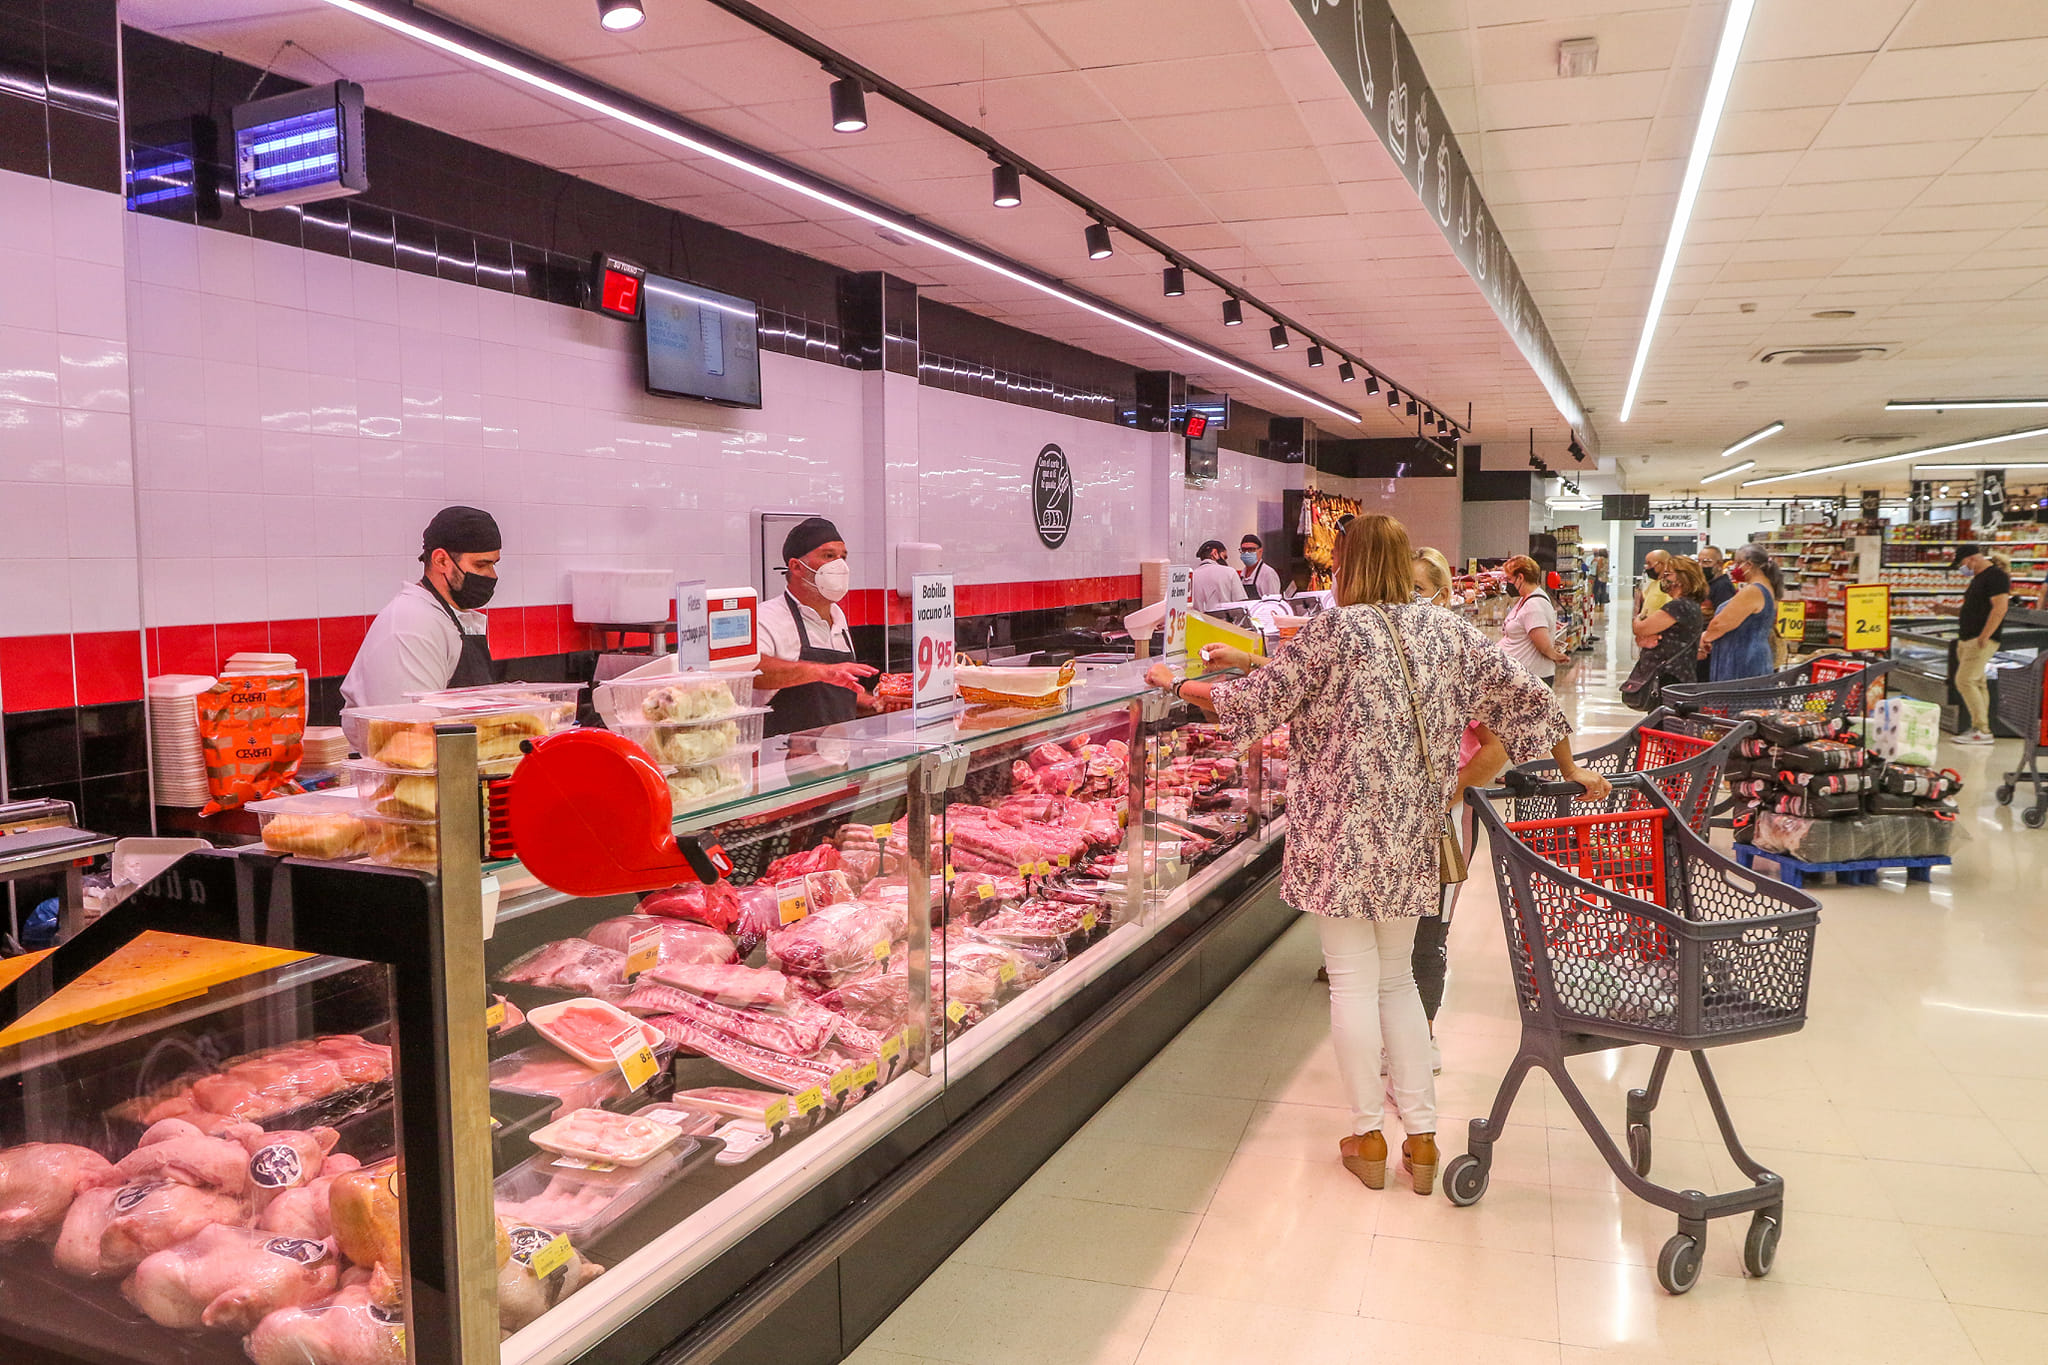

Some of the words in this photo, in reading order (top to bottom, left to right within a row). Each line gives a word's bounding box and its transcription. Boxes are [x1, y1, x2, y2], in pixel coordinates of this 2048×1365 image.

[922, 582, 946, 599] Babilla
[917, 607, 942, 621] vacuno
[943, 604, 952, 618] 1A
